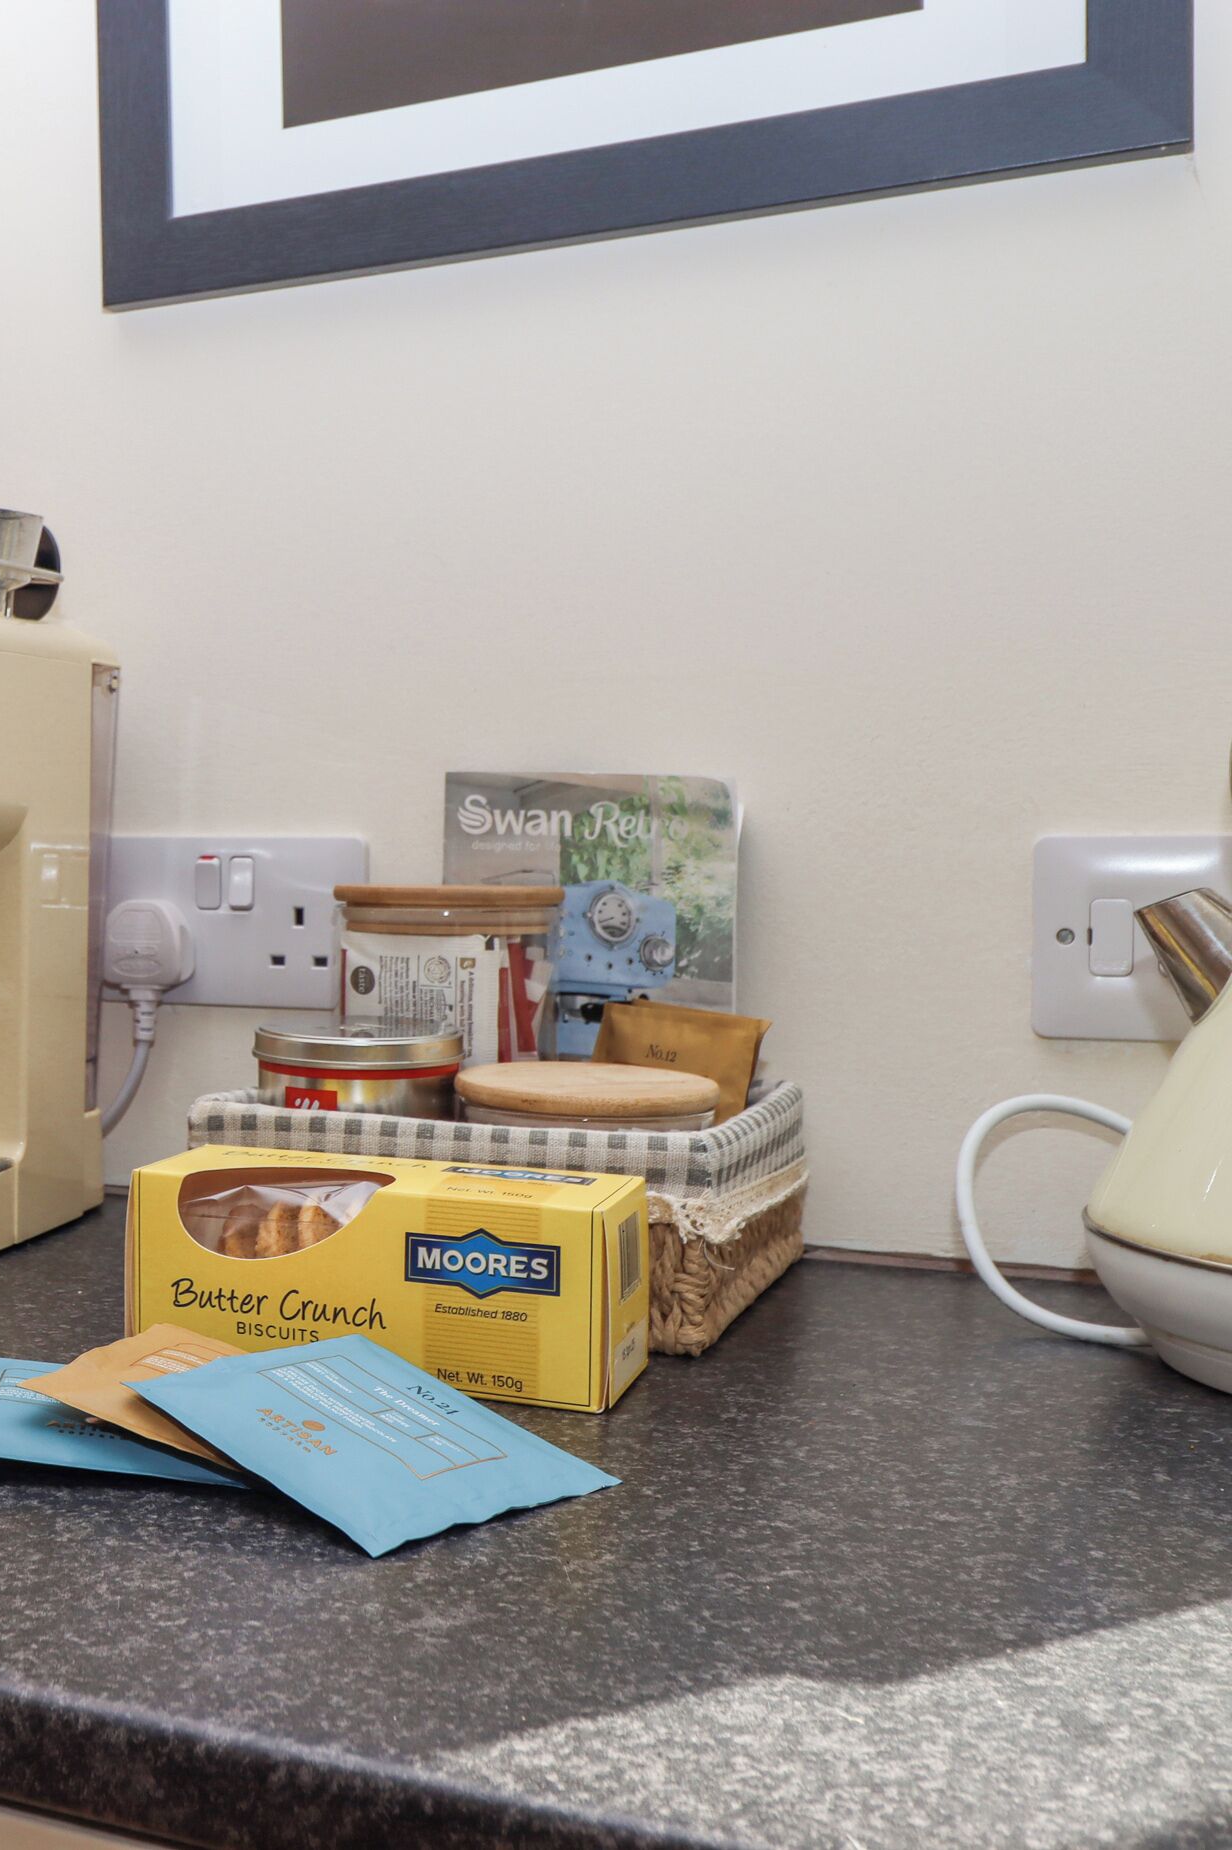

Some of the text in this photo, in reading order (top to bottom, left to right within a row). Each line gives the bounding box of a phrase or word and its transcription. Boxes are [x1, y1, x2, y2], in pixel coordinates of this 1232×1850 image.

[457, 794, 689, 848] Swan Retro
[358, 968, 368, 993] taste
[642, 1043, 677, 1063] No.12
[454, 1167, 584, 1184] MOORES
[417, 1246, 549, 1280] MOORES
[171, 1278, 387, 1329] Butter Crunch
[434, 1303, 528, 1322] Established 1880
[237, 1321, 319, 1342] BISCUITS
[437, 1368, 523, 1392] Net. Wt. 150g
[373, 1386, 394, 1400] The
[394, 1399, 441, 1427] Dreamer
[255, 1408, 338, 1456] ARTISAN
